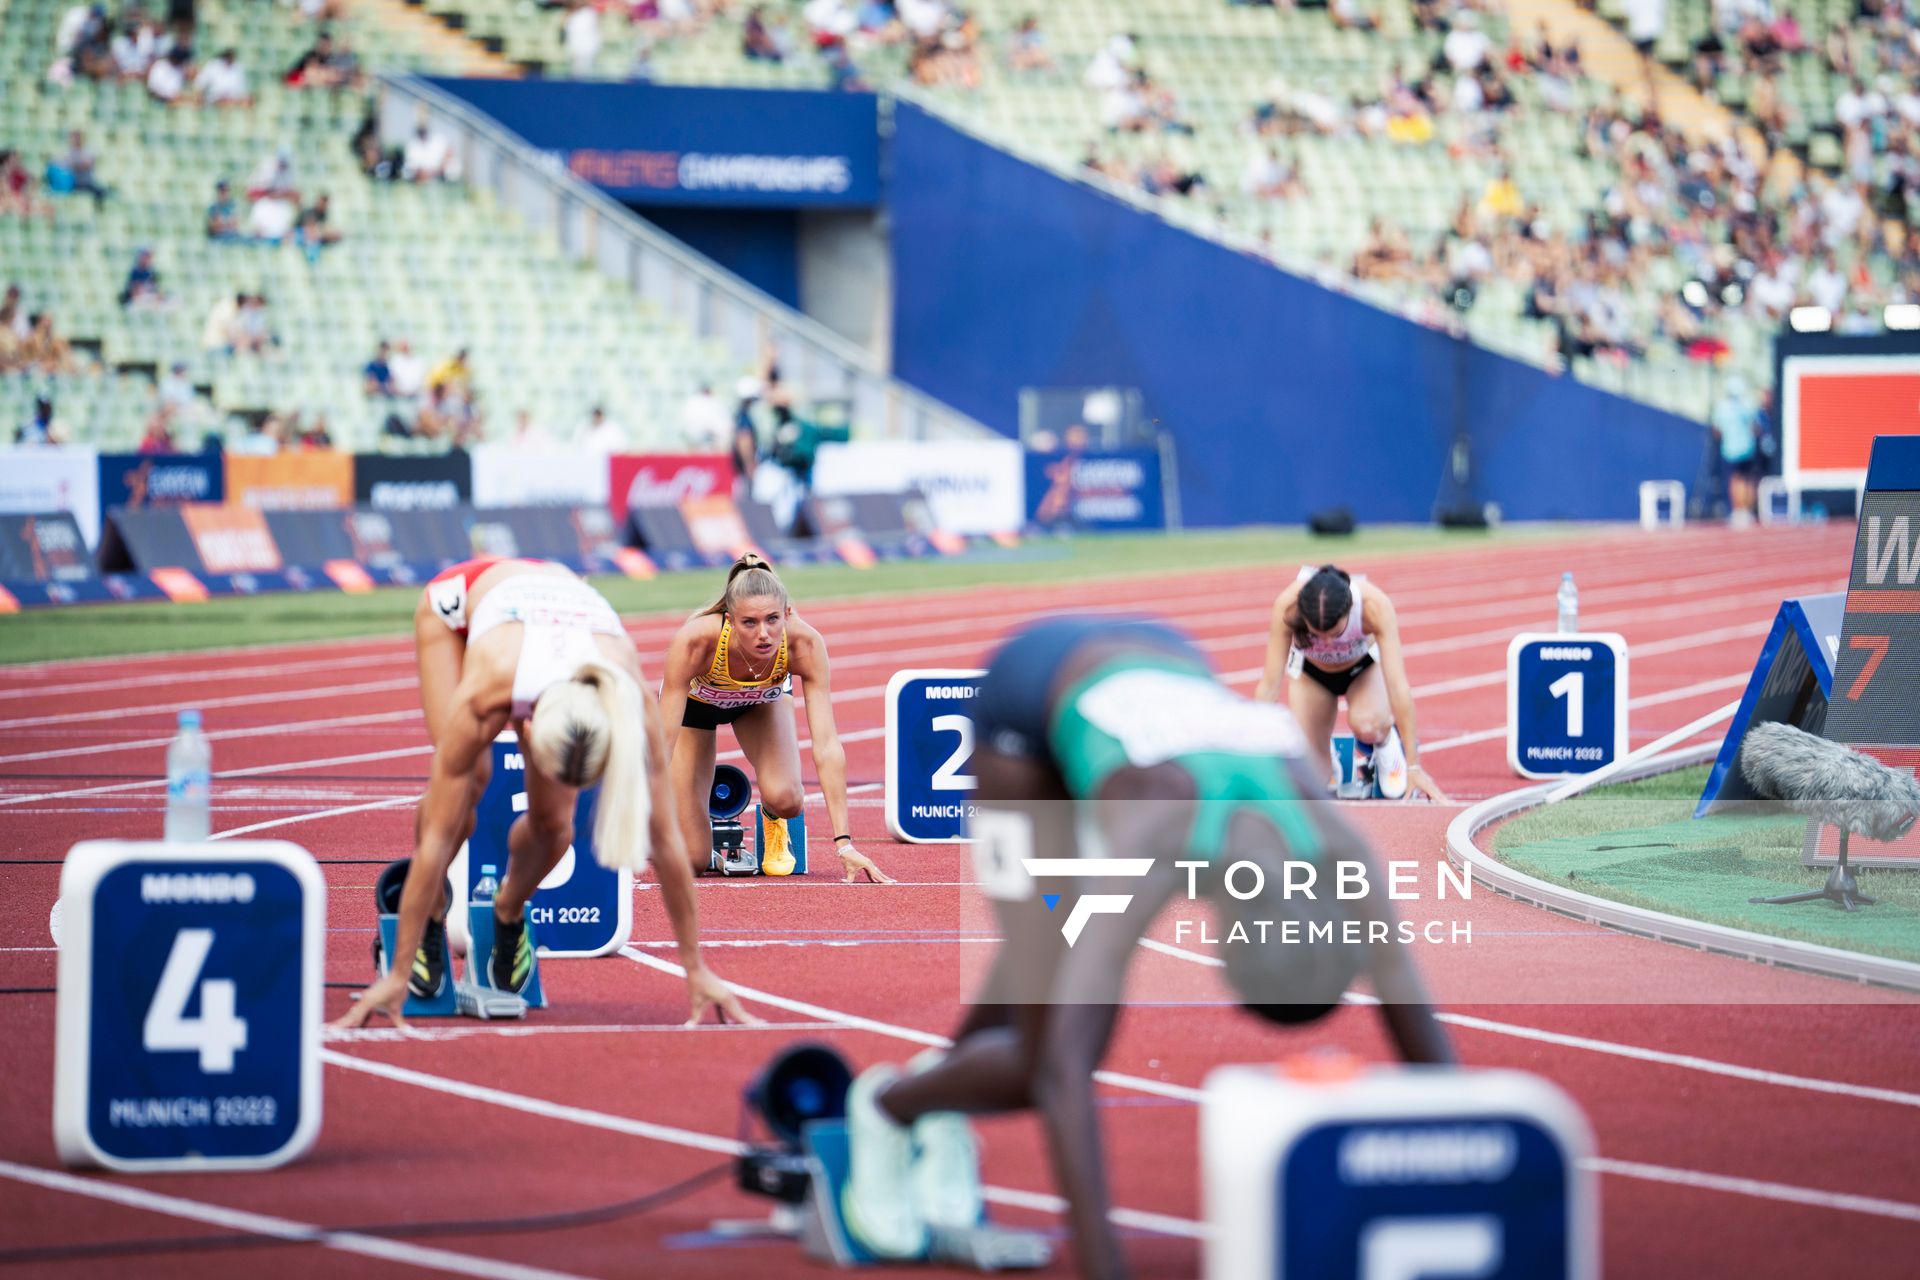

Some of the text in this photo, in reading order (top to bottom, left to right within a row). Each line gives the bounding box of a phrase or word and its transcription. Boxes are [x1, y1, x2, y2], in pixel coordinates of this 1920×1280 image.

[1540, 647, 1593, 661] MONDO
[1847, 635, 1891, 701] 7
[699, 684, 763, 700] SPAR
[1548, 671, 1584, 738] 1
[931, 714, 979, 791] 2
[1527, 747, 1603, 760] MUNICH 2022
[912, 805, 964, 819] MUNICH
[140, 872, 257, 905] MONDO
[558, 906, 601, 924] 2022
[143, 926, 249, 1075] 4
[109, 1093, 278, 1128] MUNICH 2022
